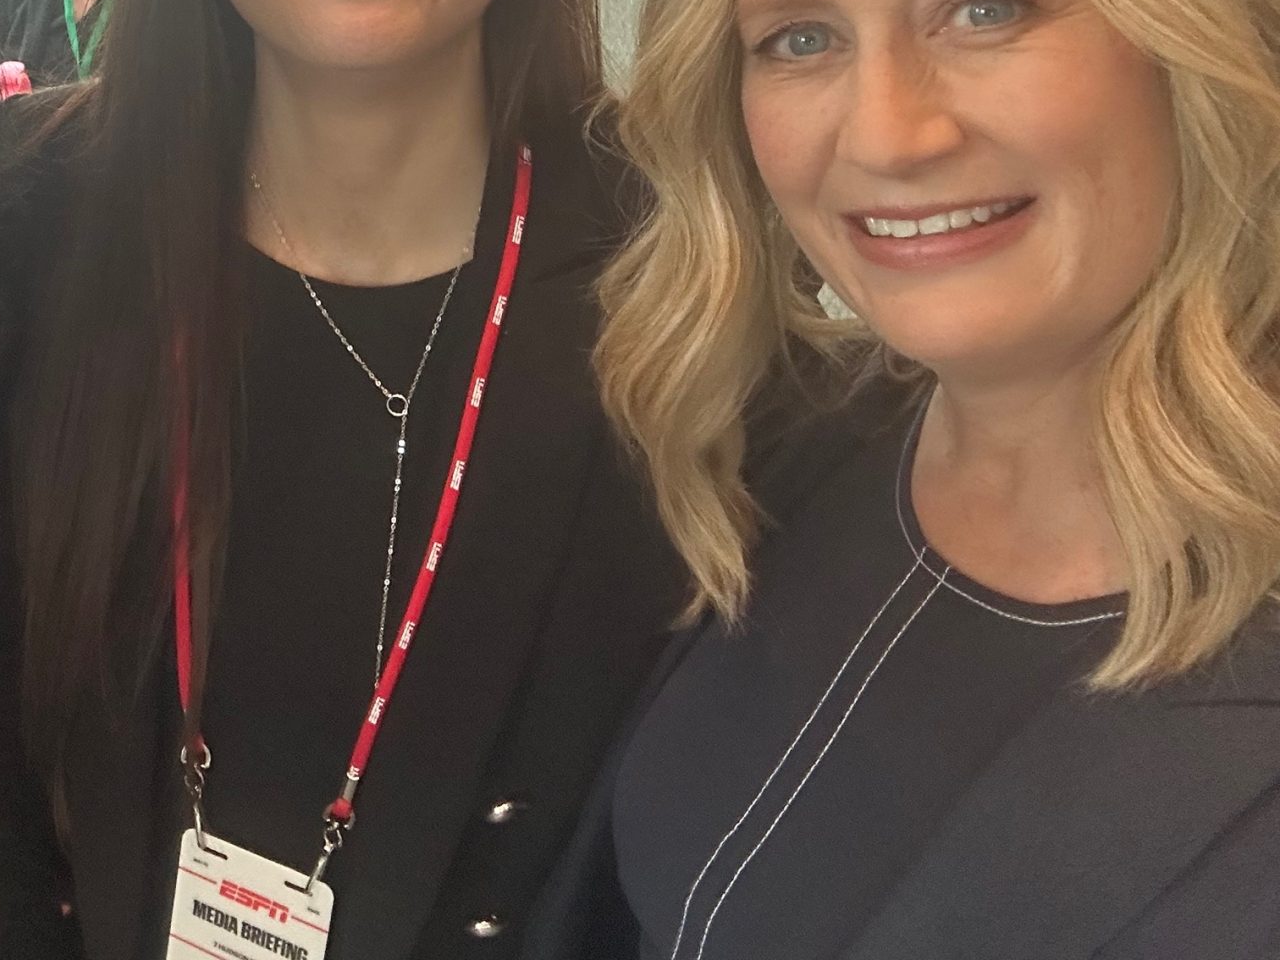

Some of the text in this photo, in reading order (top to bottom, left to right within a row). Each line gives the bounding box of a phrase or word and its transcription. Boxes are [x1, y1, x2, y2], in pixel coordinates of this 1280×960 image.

[511, 215, 525, 245] ESPN
[491, 295, 508, 326] ESPN
[470, 377, 486, 408] ESPN
[449, 459, 466, 491] ESPN
[425, 541, 443, 572] ESPN
[398, 620, 416, 650] ESPN
[367, 696, 386, 725] ESPN
[219, 880, 289, 924] ESPN
[192, 899, 238, 936] MEDIA
[240, 921, 309, 960] BRIEFING
